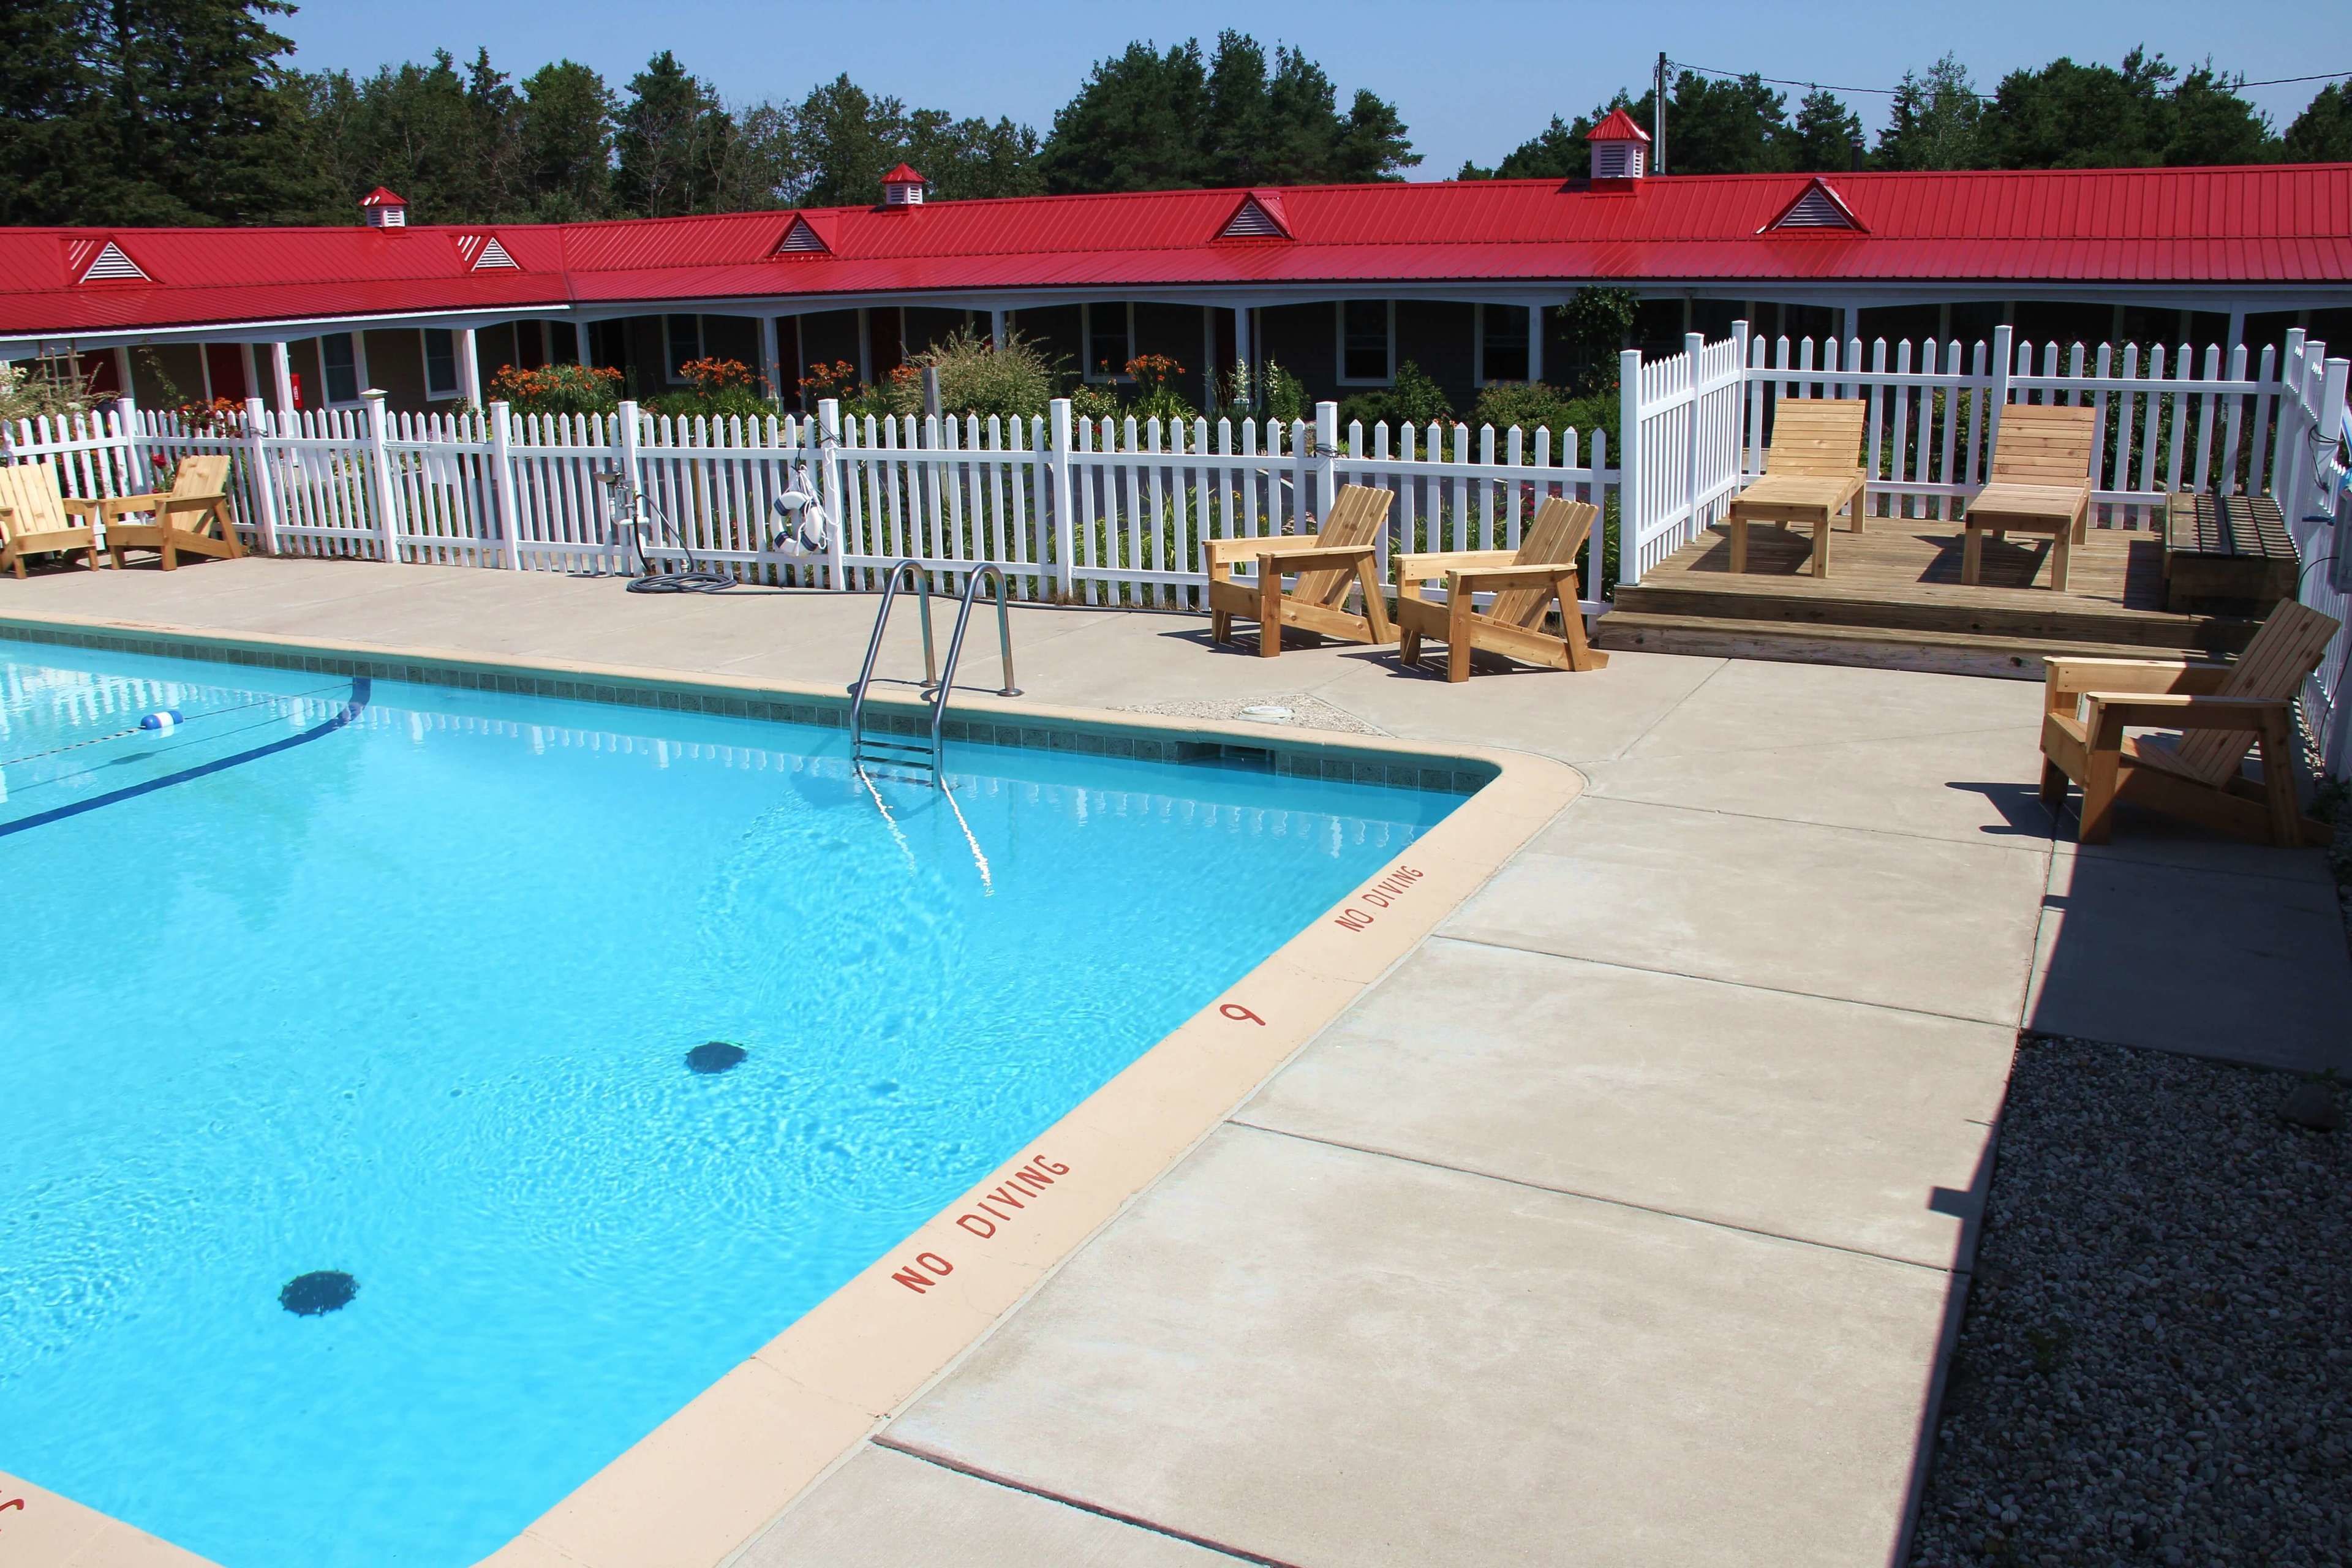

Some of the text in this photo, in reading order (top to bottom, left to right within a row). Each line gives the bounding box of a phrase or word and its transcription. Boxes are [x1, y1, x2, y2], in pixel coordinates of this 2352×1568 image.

[1334, 865, 1424, 932] NO DIVING
[1219, 1003, 1266, 1027] 9
[891, 1154, 1070, 1294] NO DIVING
